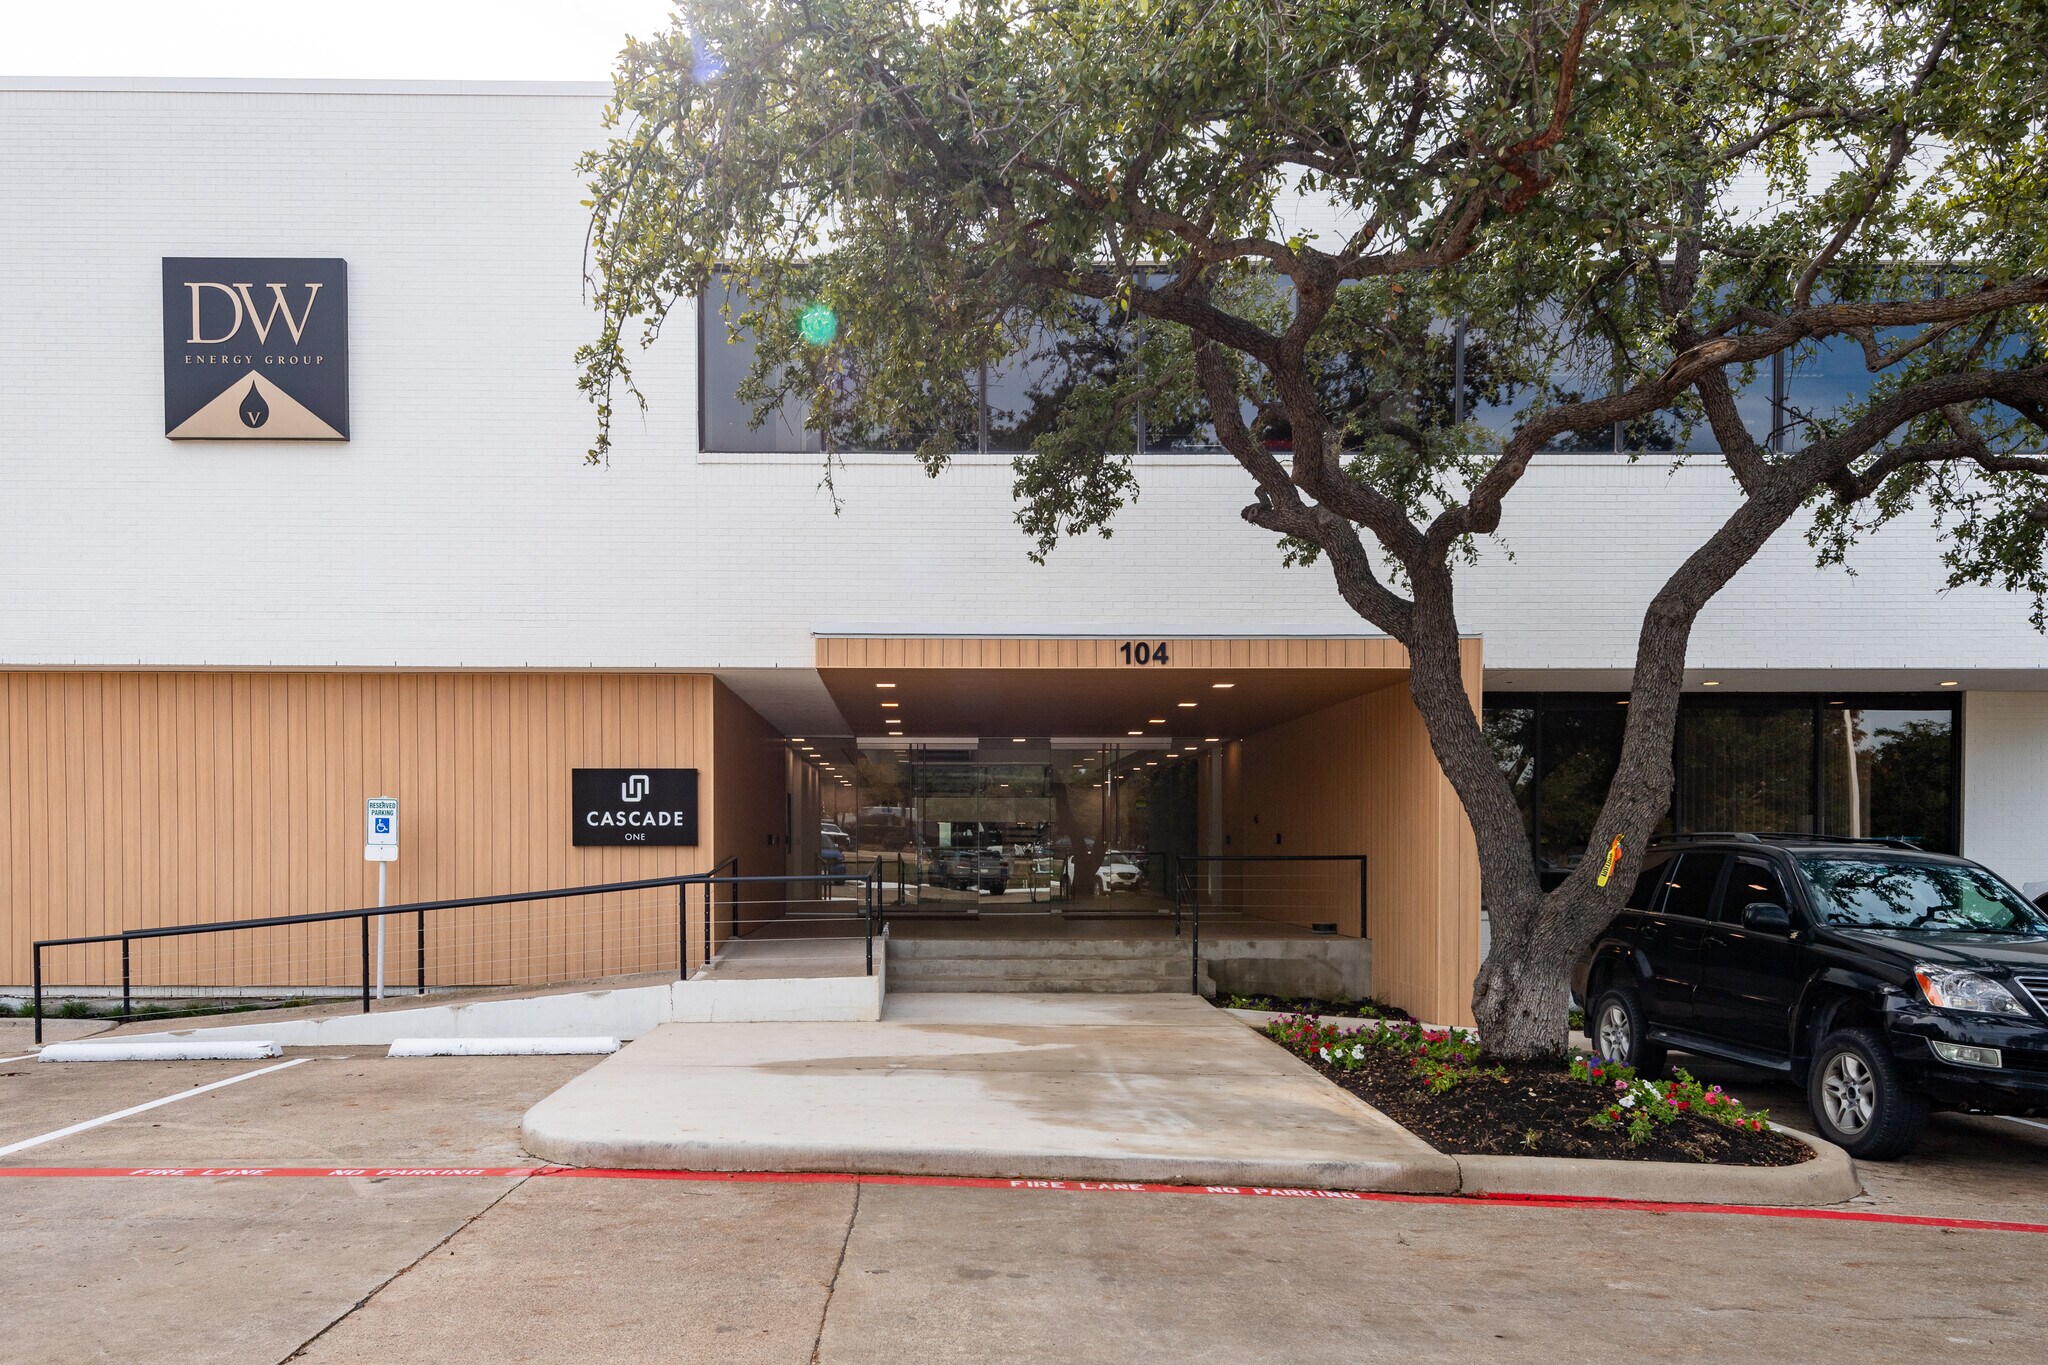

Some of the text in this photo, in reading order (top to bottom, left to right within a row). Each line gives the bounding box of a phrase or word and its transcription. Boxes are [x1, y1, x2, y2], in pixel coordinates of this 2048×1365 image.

[183, 281, 323, 346] DW
[185, 355, 324, 365] ENERGY GROUP
[246, 411, 261, 426] V
[1120, 641, 1169, 665] 104
[586, 811, 683, 827] CASCADE
[624, 833, 645, 841] ONE
[1010, 1180, 1361, 1199] FIRE LANE NO PARKING
